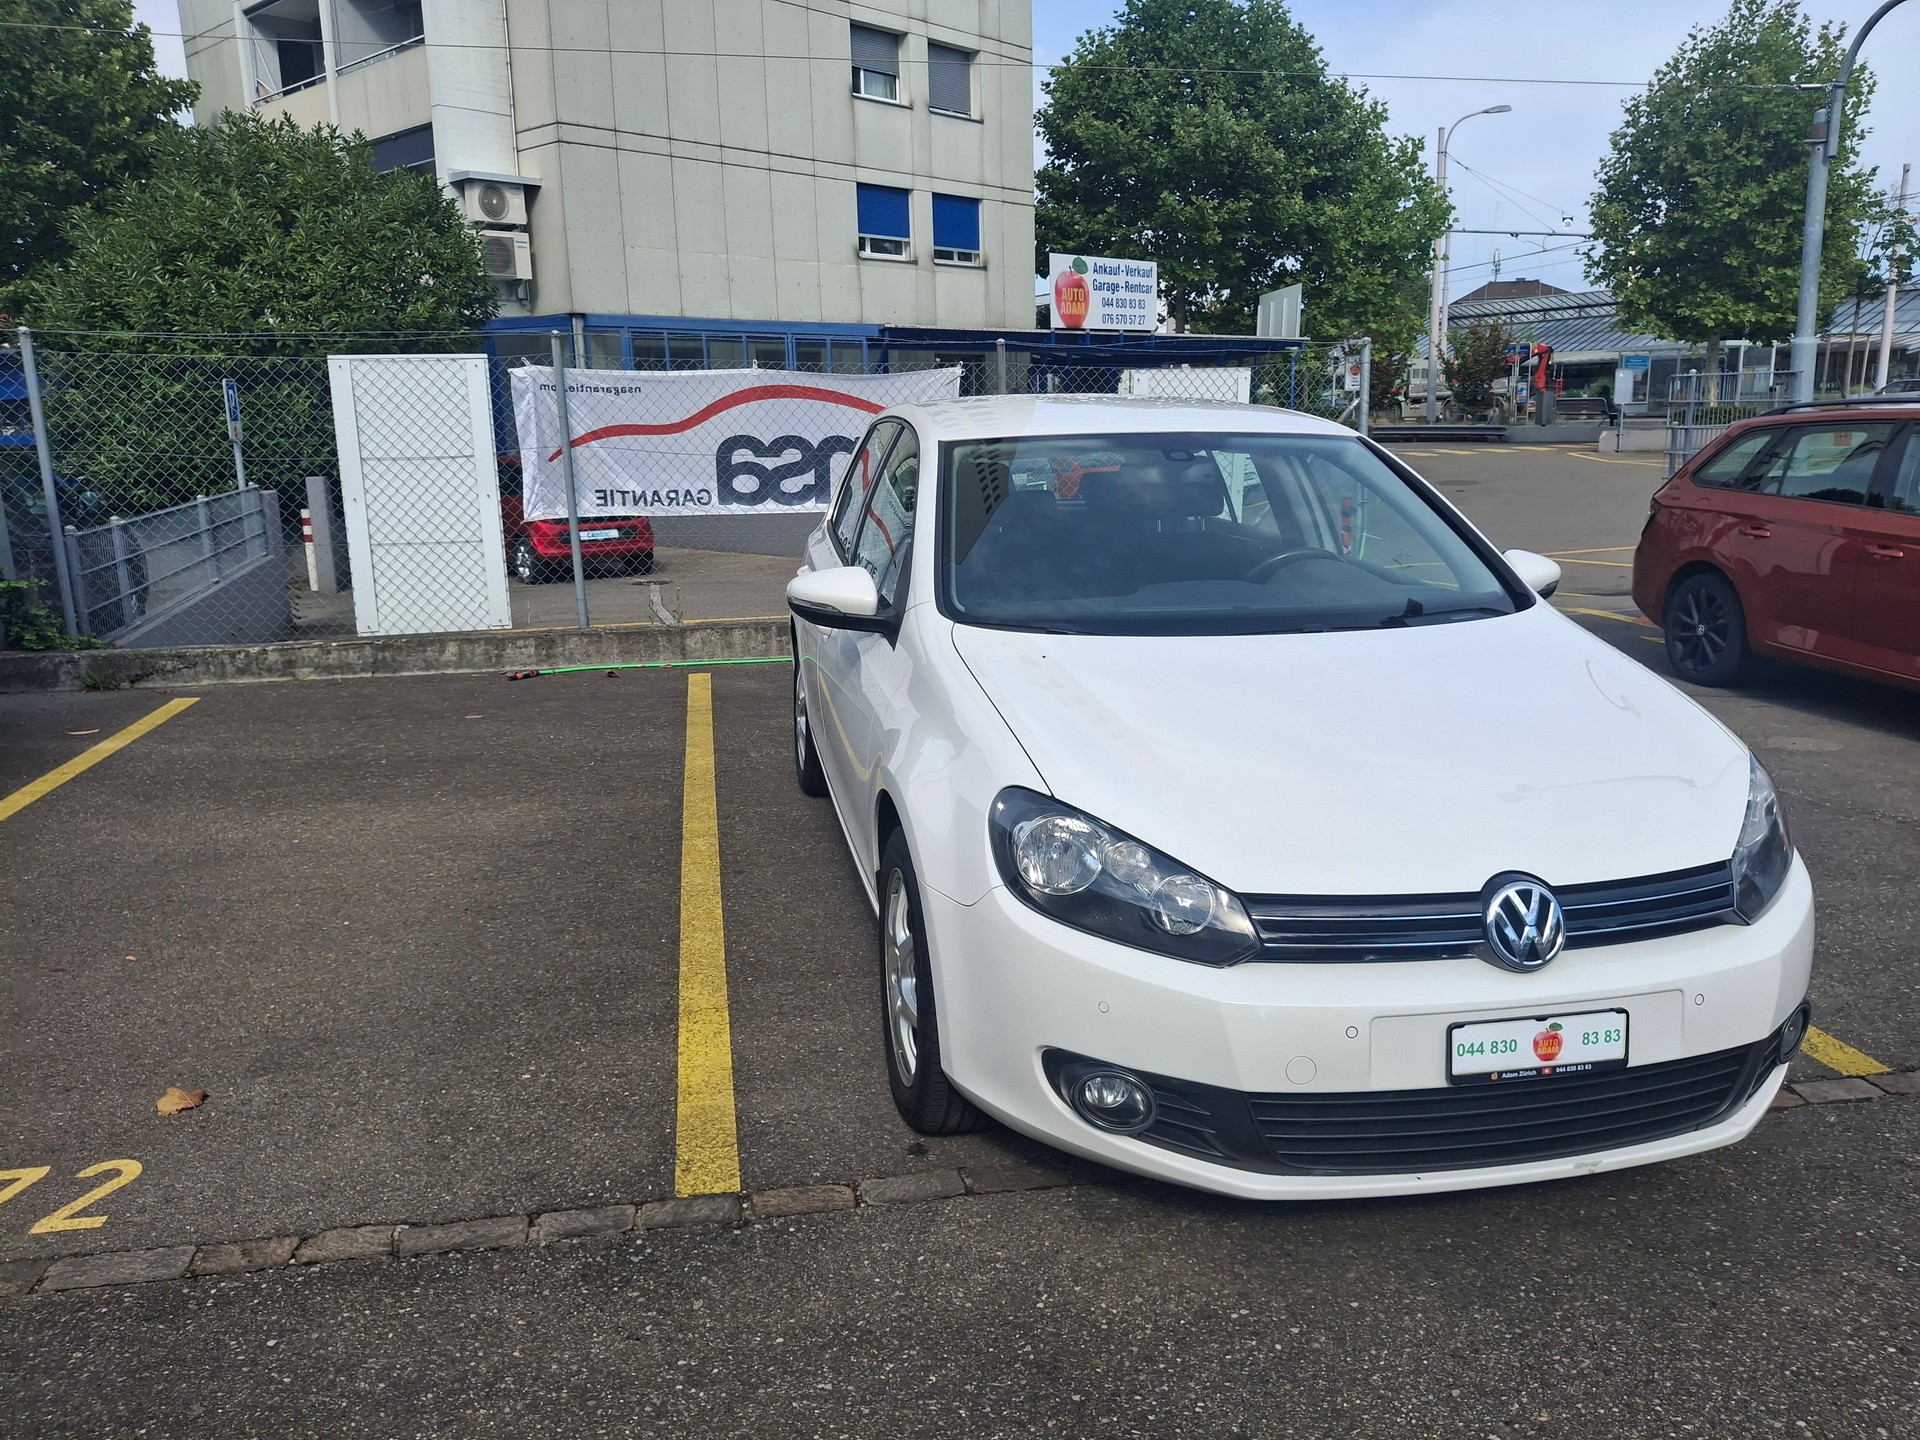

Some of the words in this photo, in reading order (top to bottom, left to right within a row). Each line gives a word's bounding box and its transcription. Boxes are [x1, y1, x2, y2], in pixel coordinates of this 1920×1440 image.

[1093, 262, 1153, 278] Ankauf-Verkauf
[1062, 287, 1084, 301] AUTO
[1093, 279, 1153, 295] Garage-Rentcar
[1061, 301, 1085, 315] ADAM
[1102, 297, 1114, 308] 044
[1116, 298, 1128, 309] 830
[1129, 299, 1136, 309] 83
[1138, 299, 1146, 310] 83
[1102, 314, 1114, 324] 076
[1116, 314, 1128, 324] 570
[1129, 315, 1136, 325] 57
[1138, 315, 1146, 325] 27
[1538, 1039, 1558, 1047] AUTO
[1582, 1031, 1599, 1046] 83
[1604, 1028, 1621, 1043] 83
[1457, 1042, 1485, 1057] 044
[1490, 1039, 1518, 1054] 830
[1537, 1046, 1558, 1055] ADAM
[1519, 1069, 1536, 1077] Zürich
